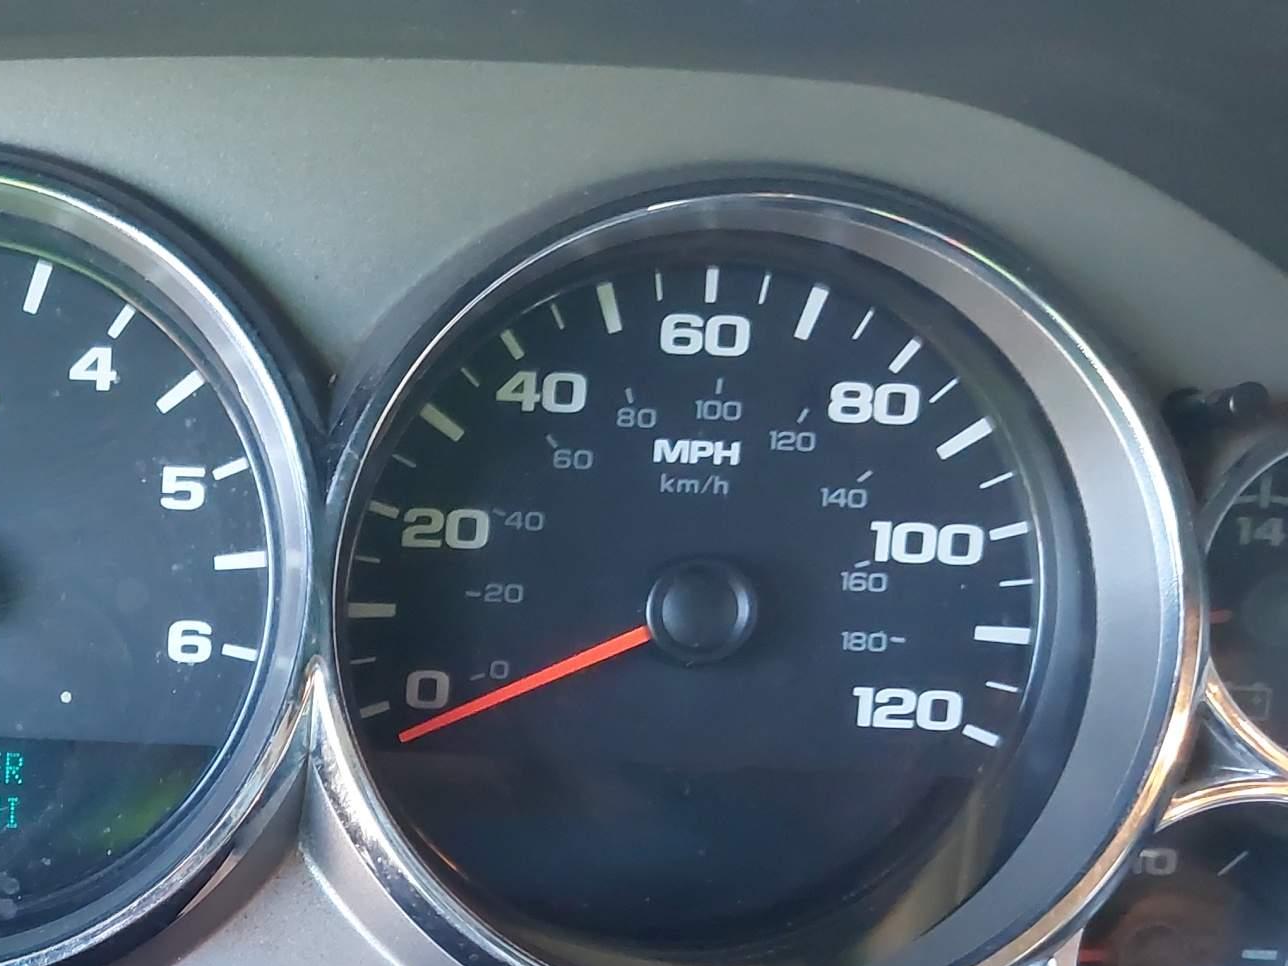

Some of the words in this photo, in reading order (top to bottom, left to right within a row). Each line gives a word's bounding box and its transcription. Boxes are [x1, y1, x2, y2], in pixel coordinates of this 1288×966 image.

[660, 314, 750, 356] 60
[69, 348, 116, 391] 4
[497, 371, 585, 413] 40
[828, 381, 918, 425] 80
[617, 406, 656, 429] 80
[696, 399, 742, 422] 100
[653, 439, 740, 466] MPH
[770, 430, 816, 452] 120
[553, 448, 593, 470] 60
[160, 466, 205, 510] 5
[660, 475, 729, 496] km/h
[822, 487, 866, 509] 140
[401, 509, 489, 550] 20
[505, 511, 544, 531] 40
[872, 522, 982, 565] 100
[484, 584, 523, 603] 20
[841, 571, 887, 592] 160
[167, 620, 210, 662] 6
[842, 632, 886, 653] 180
[490, 661, 509, 680] 0
[405, 670, 448, 709] 0
[853, 687, 962, 730] 120
